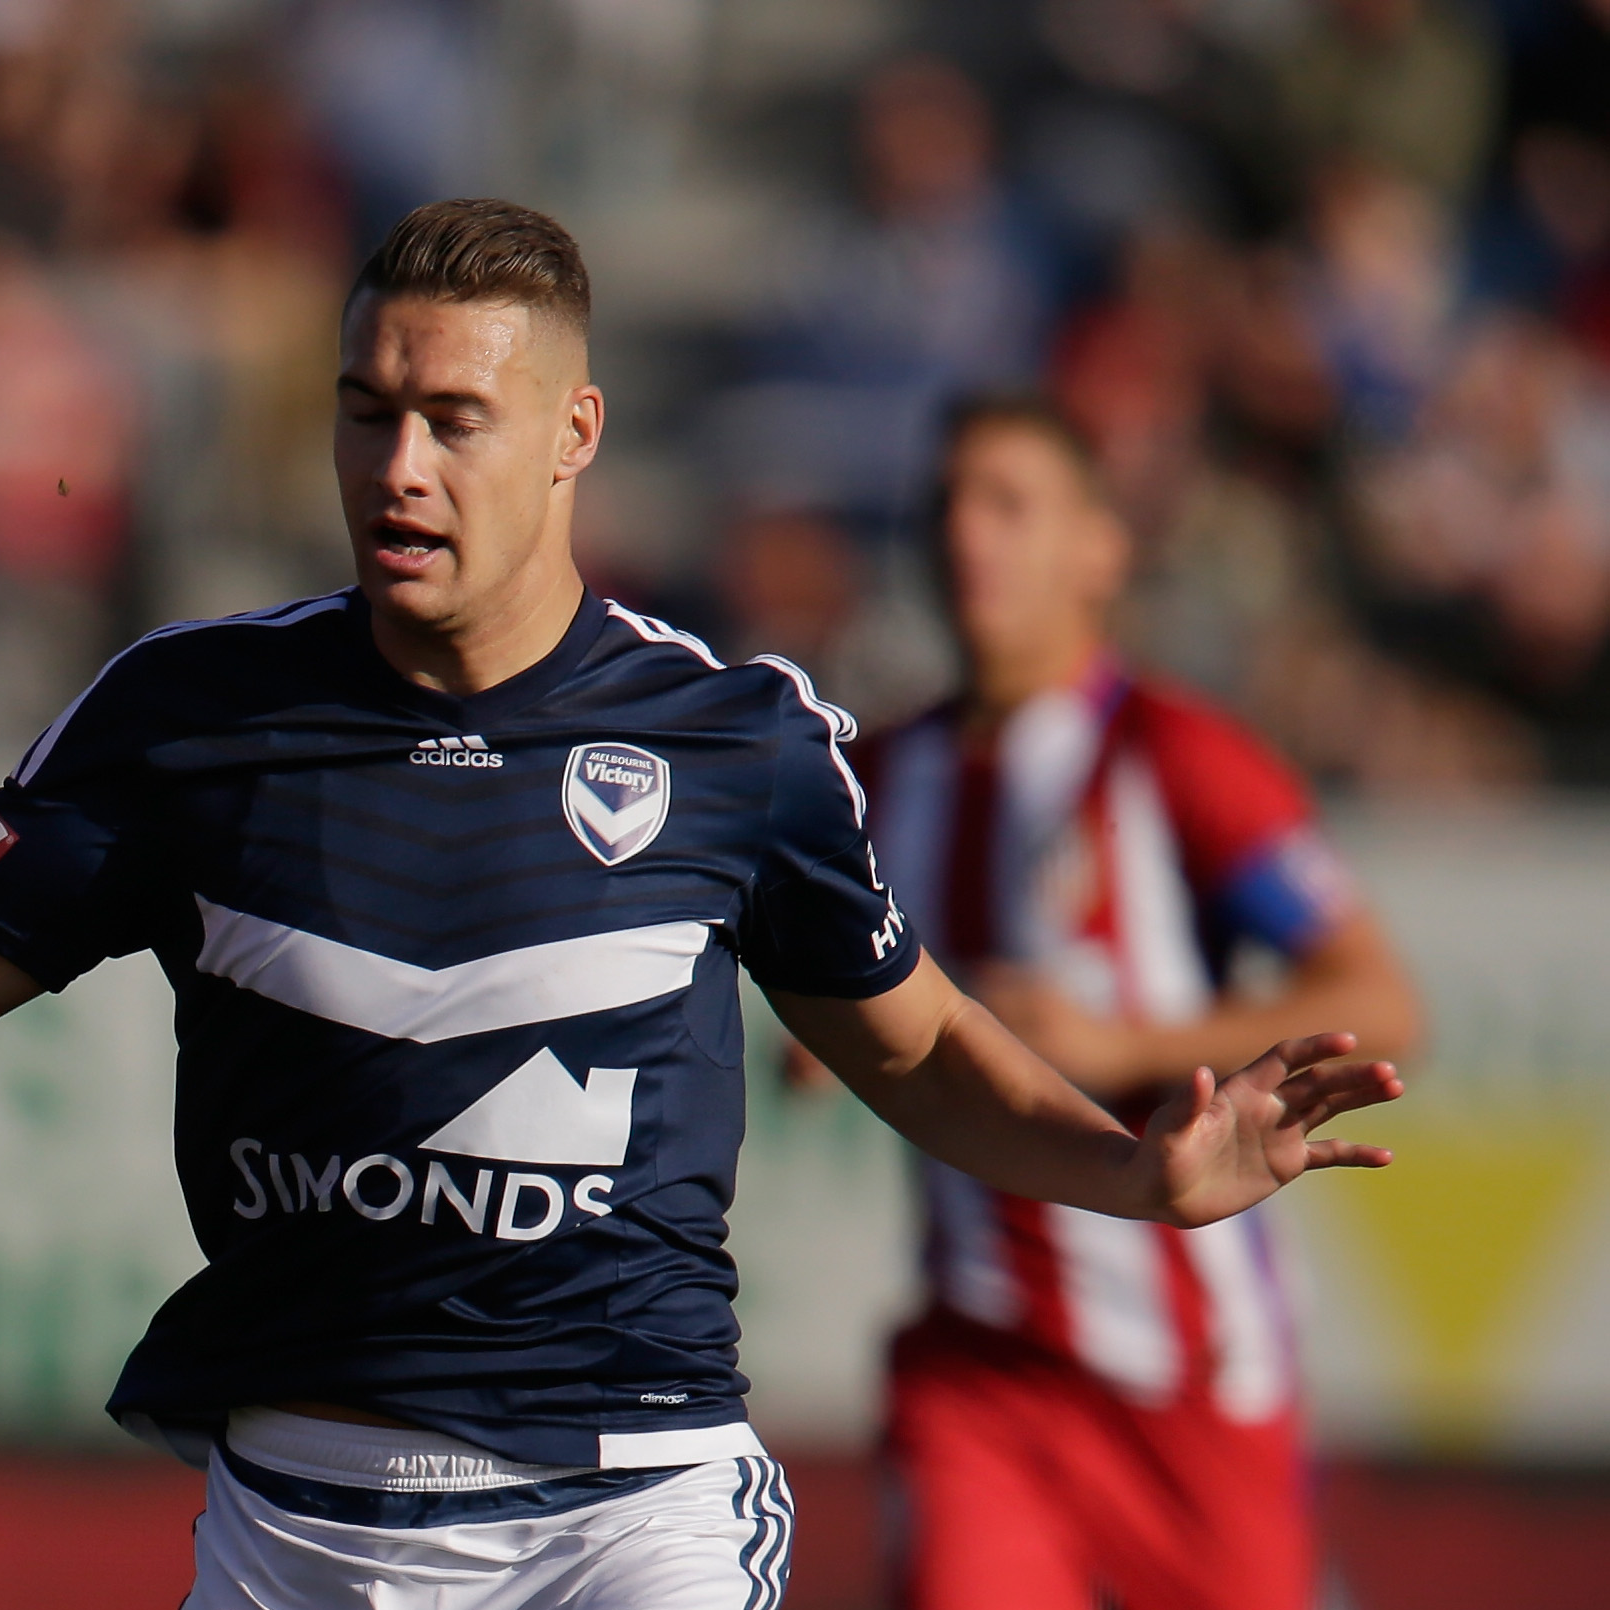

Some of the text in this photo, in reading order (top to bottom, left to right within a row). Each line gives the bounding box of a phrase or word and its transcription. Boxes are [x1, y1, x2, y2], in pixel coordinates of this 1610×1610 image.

[409, 747, 504, 769] adidas
[588, 751, 654, 771] MELBOURNE
[585, 760, 655, 794] Victory
[871, 886, 905, 960] HY
[229, 1136, 616, 1242] SIMONDS
